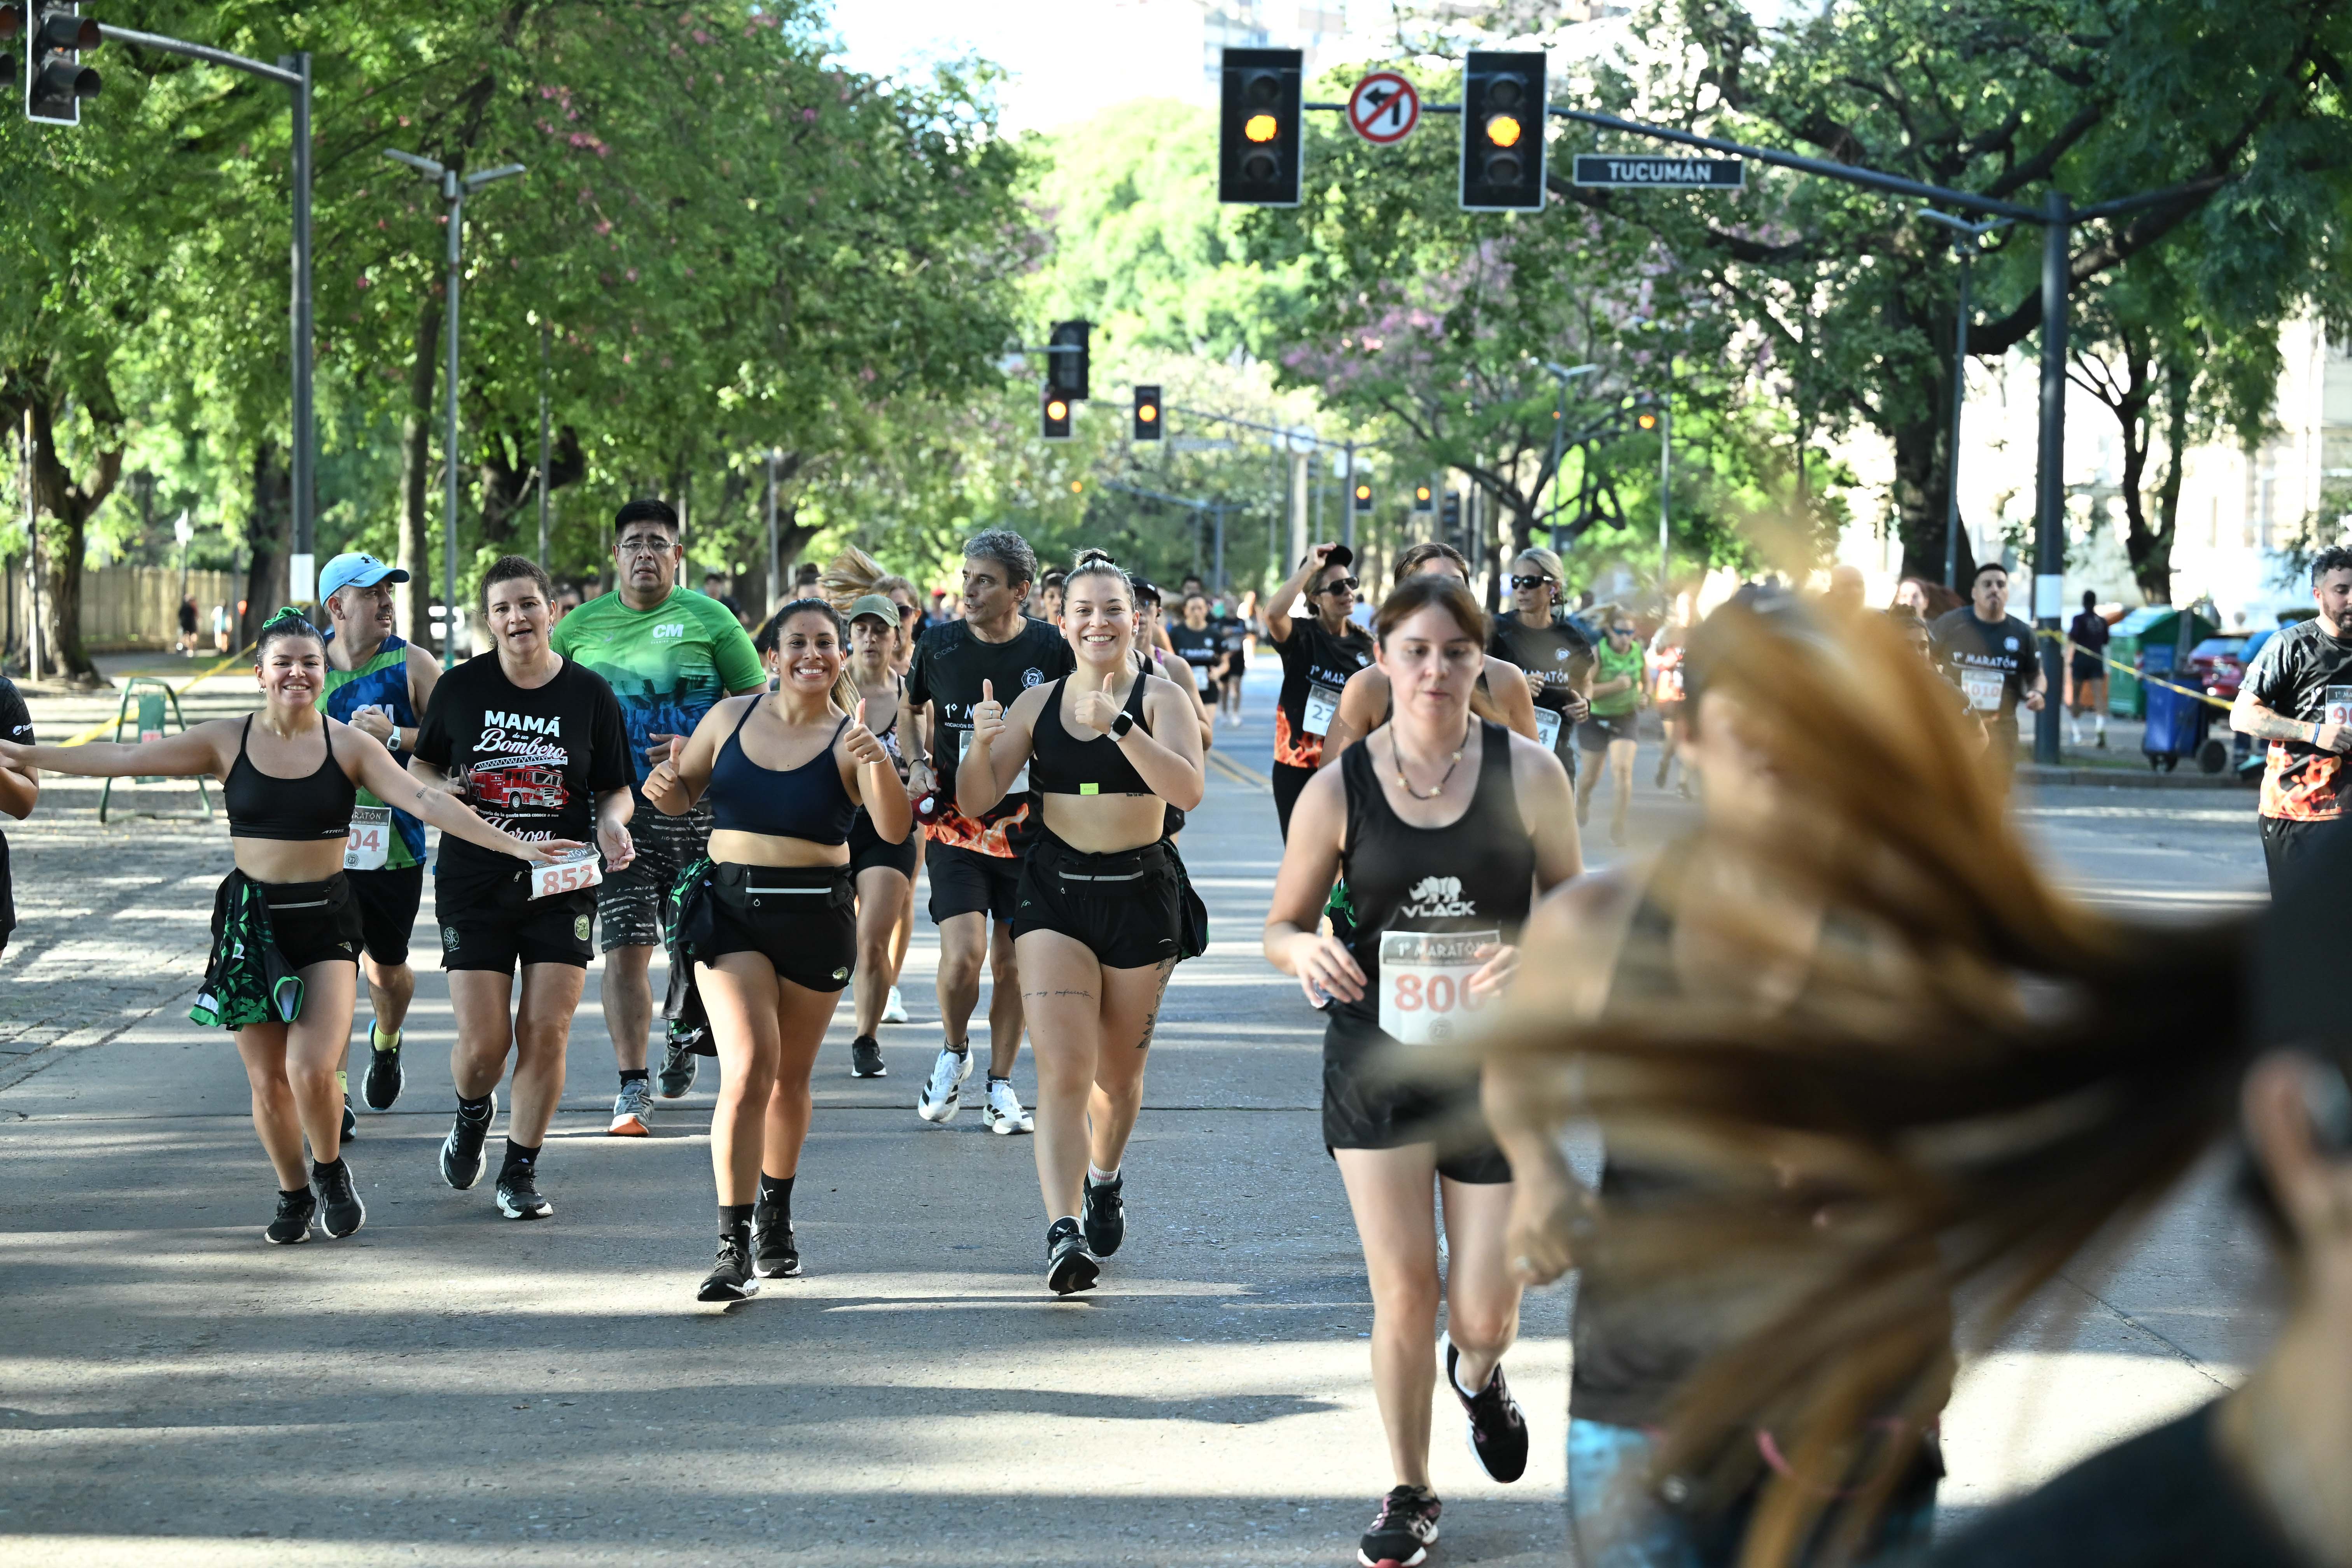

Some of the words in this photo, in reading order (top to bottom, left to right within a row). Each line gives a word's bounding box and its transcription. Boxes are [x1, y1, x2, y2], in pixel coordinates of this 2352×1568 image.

[1607, 156, 1711, 182] TUCUMÁN
[653, 624, 684, 638] CM
[1321, 669, 1347, 685] MAR
[485, 710, 561, 737] MAMÁ
[2333, 707, 2352, 725] 9
[473, 728, 567, 759] Bombero
[542, 865, 595, 895] 852
[1400, 900, 1476, 919] VLACK
